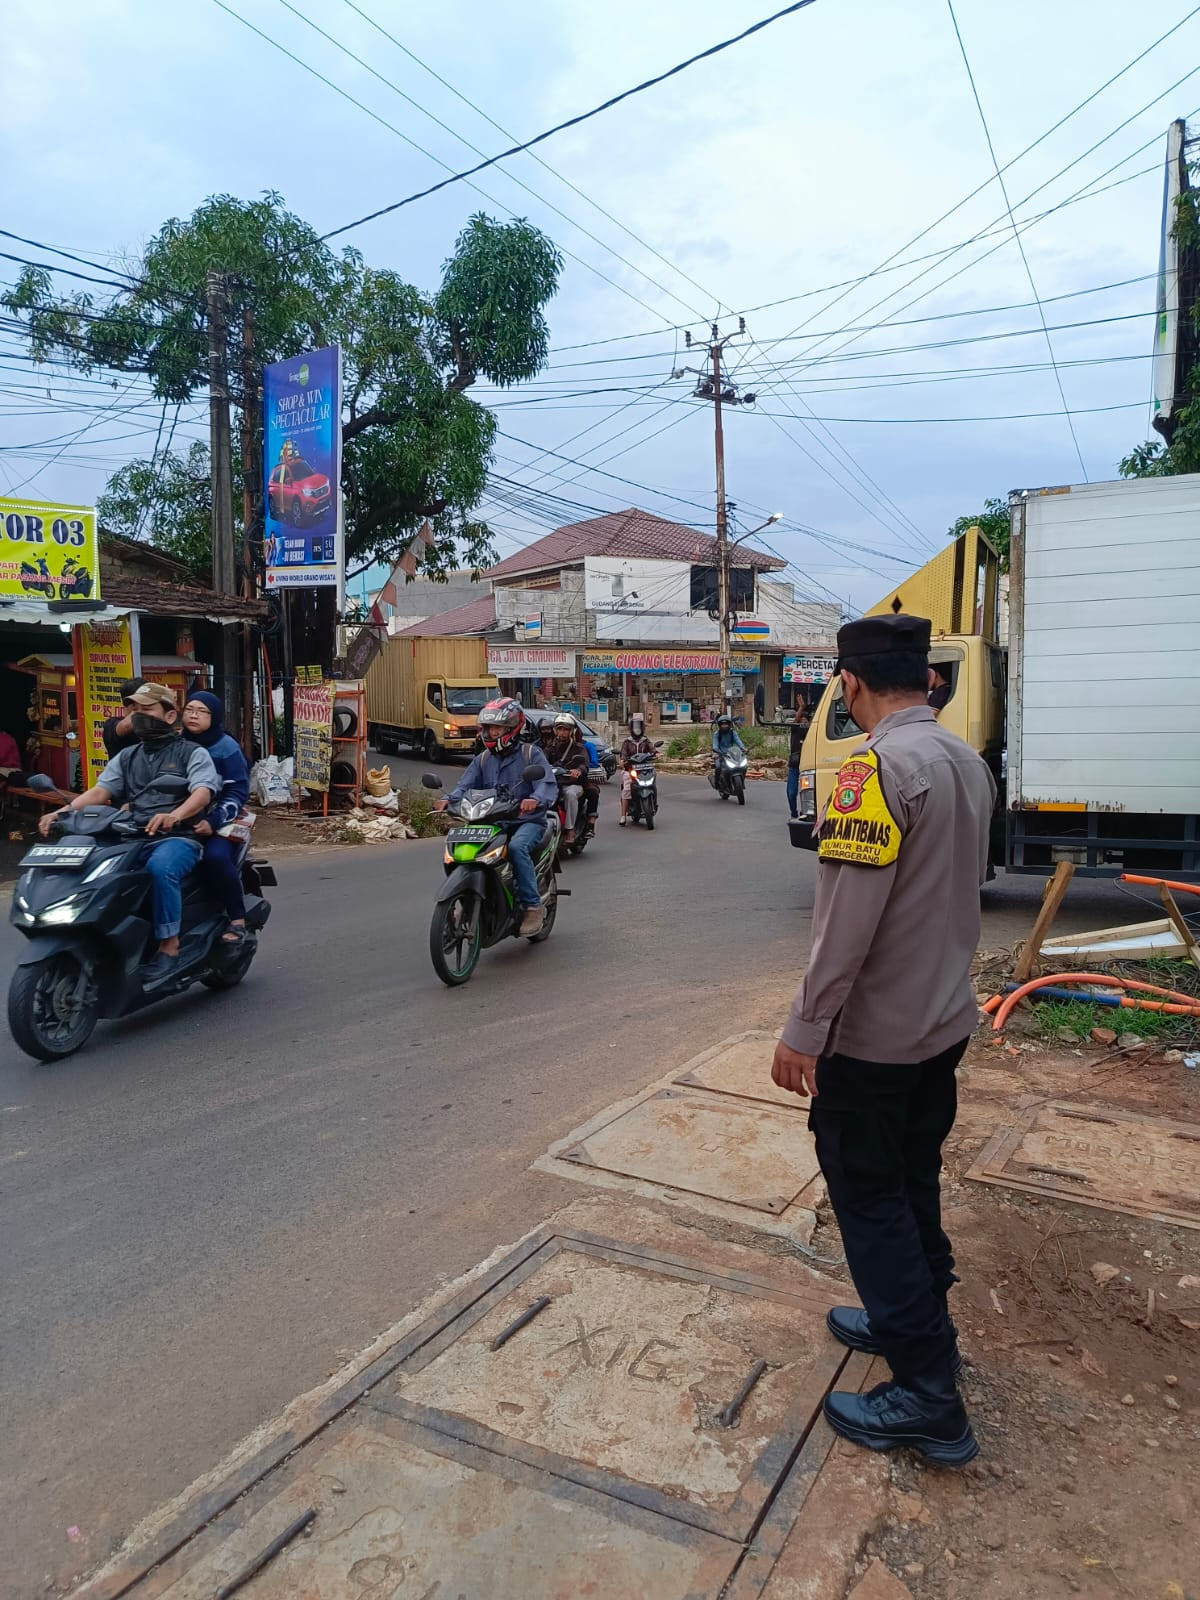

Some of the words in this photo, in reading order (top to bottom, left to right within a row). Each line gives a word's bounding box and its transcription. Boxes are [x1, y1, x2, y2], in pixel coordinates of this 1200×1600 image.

[278, 395, 298, 412] SHOP
[299, 393, 305, 407] &
[307, 389, 322, 404] WIN
[272, 404, 329, 429] SPECTACULAR
[52, 518, 85, 546] 03
[504, 651, 525, 663] JAYA
[615, 654, 660, 669] GUDANG
[663, 655, 728, 669] ELEKTRONI
[294, 685, 331, 703] BENGKEL
[293, 701, 331, 724] MOTOR
[855, 846, 881, 857] BATU
